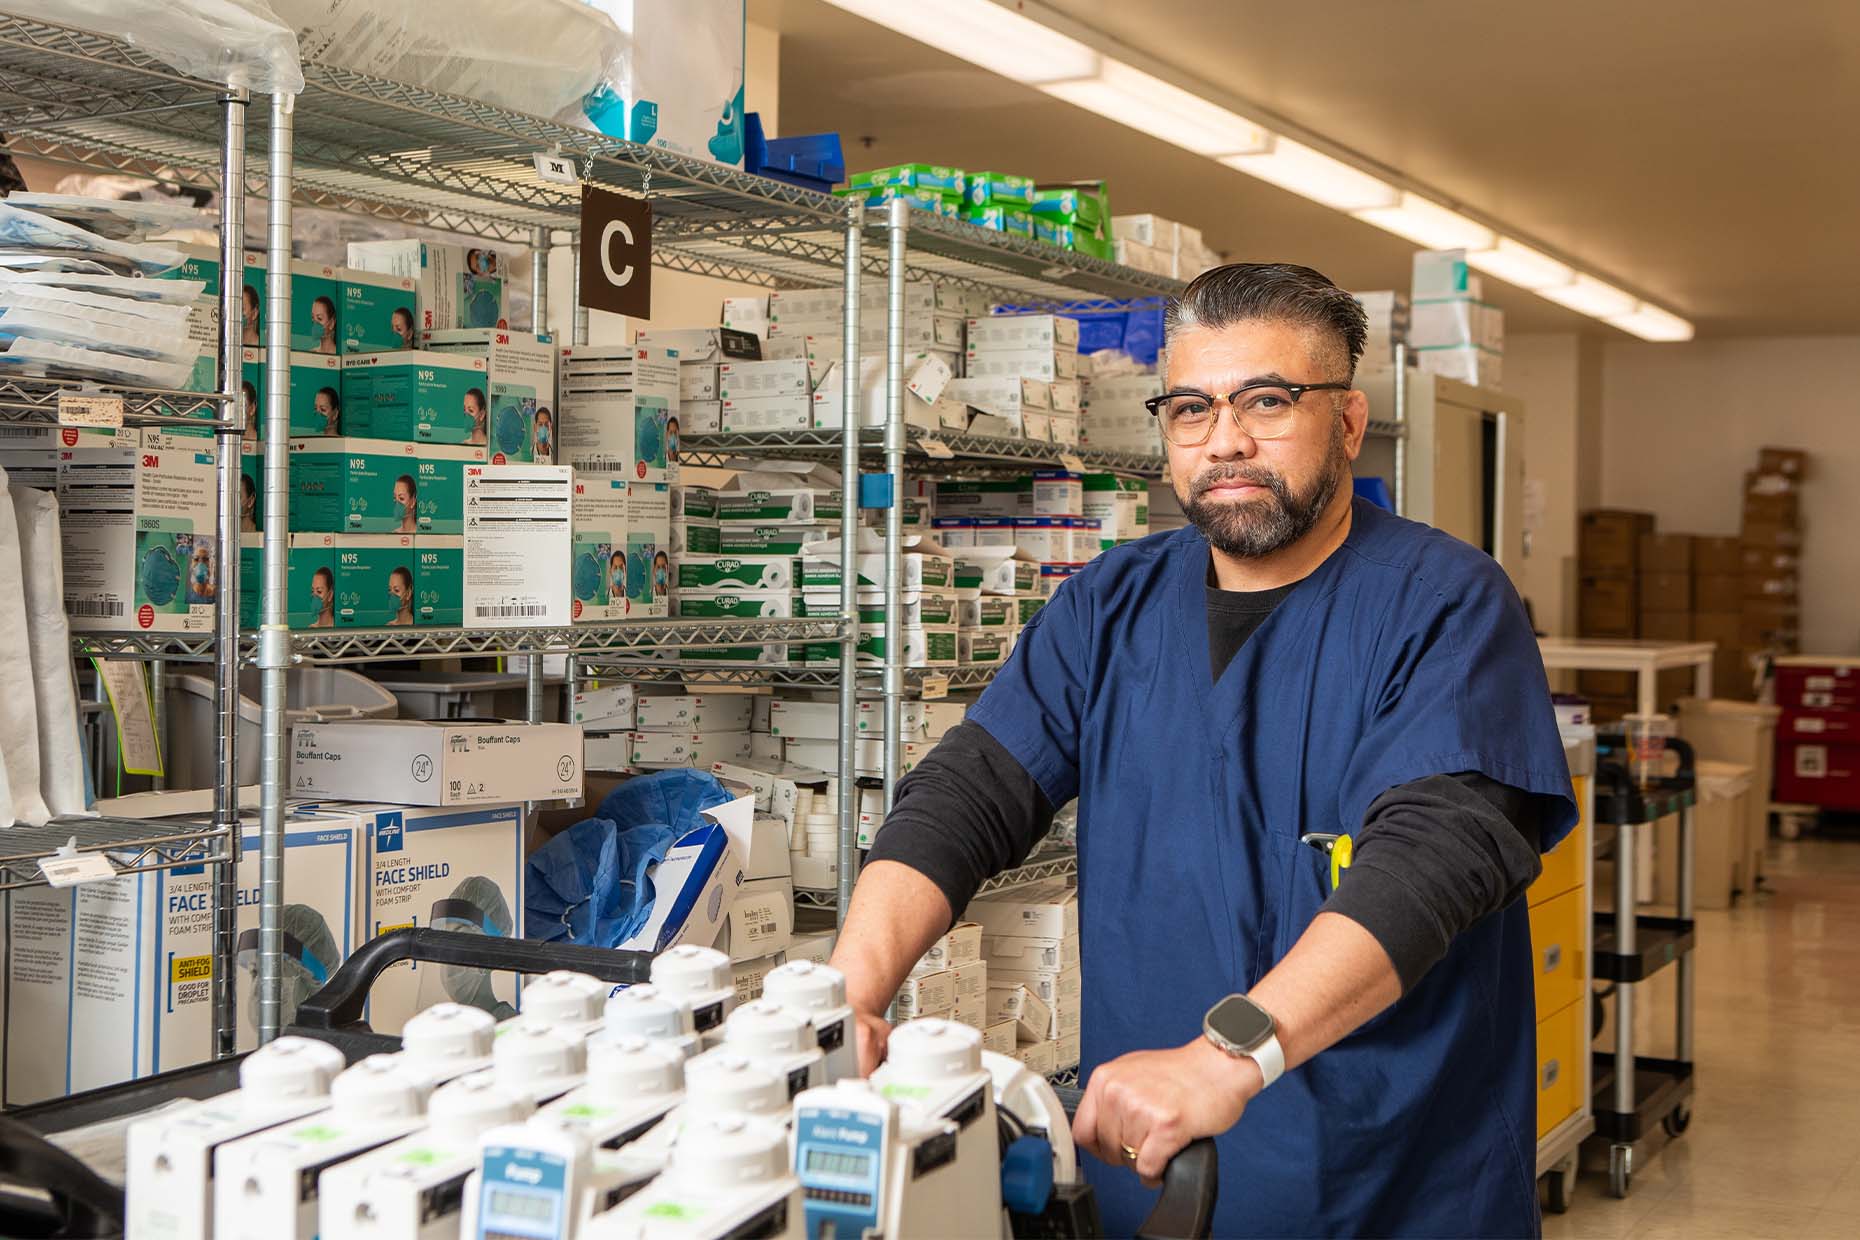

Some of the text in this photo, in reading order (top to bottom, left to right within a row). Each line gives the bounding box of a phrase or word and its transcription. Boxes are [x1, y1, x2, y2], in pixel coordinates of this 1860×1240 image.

[600, 219, 634, 287] C
[182, 263, 199, 275] N95
[346, 287, 362, 298] N95
[425, 310, 432, 329] 3M
[496, 334, 510, 345] 3M
[638, 350, 648, 360] 3M
[418, 370, 435, 381] N95
[60, 452, 73, 461] 3M
[142, 454, 159, 468] 3M
[350, 458, 365, 470] N95
[419, 464, 435, 475] N95
[467, 468, 482, 476] 3M
[575, 484, 584, 495] M
[141, 519, 160, 529] 1860S
[755, 528, 778, 536] CURAD
[341, 553, 358, 564] N95
[421, 553, 438, 564] N95
[716, 560, 740, 568] CURAD
[716, 596, 739, 604] CURAD
[477, 734, 520, 744] Bouffant Caps
[296, 750, 341, 761] Bouffant Caps
[308, 777, 313, 786] 2
[449, 780, 461, 791] 100
[479, 783, 484, 792] 2
[375, 857, 411, 870] 3/4 LENGTH
[375, 863, 450, 887] FACE SHIELD
[169, 885, 182, 894] 3/4
[375, 883, 421, 898] WITH COMFORT
[168, 893, 208, 913] FACE
[375, 895, 412, 907] FOAM STRIP
[168, 915, 190, 925] WITH
[169, 926, 191, 936] FOAM
[178, 958, 210, 969] ANTI-FOG
[178, 965, 210, 979] SHIELD
[178, 981, 209, 992] GOOD FOR
[178, 988, 209, 1000] DROPLET
